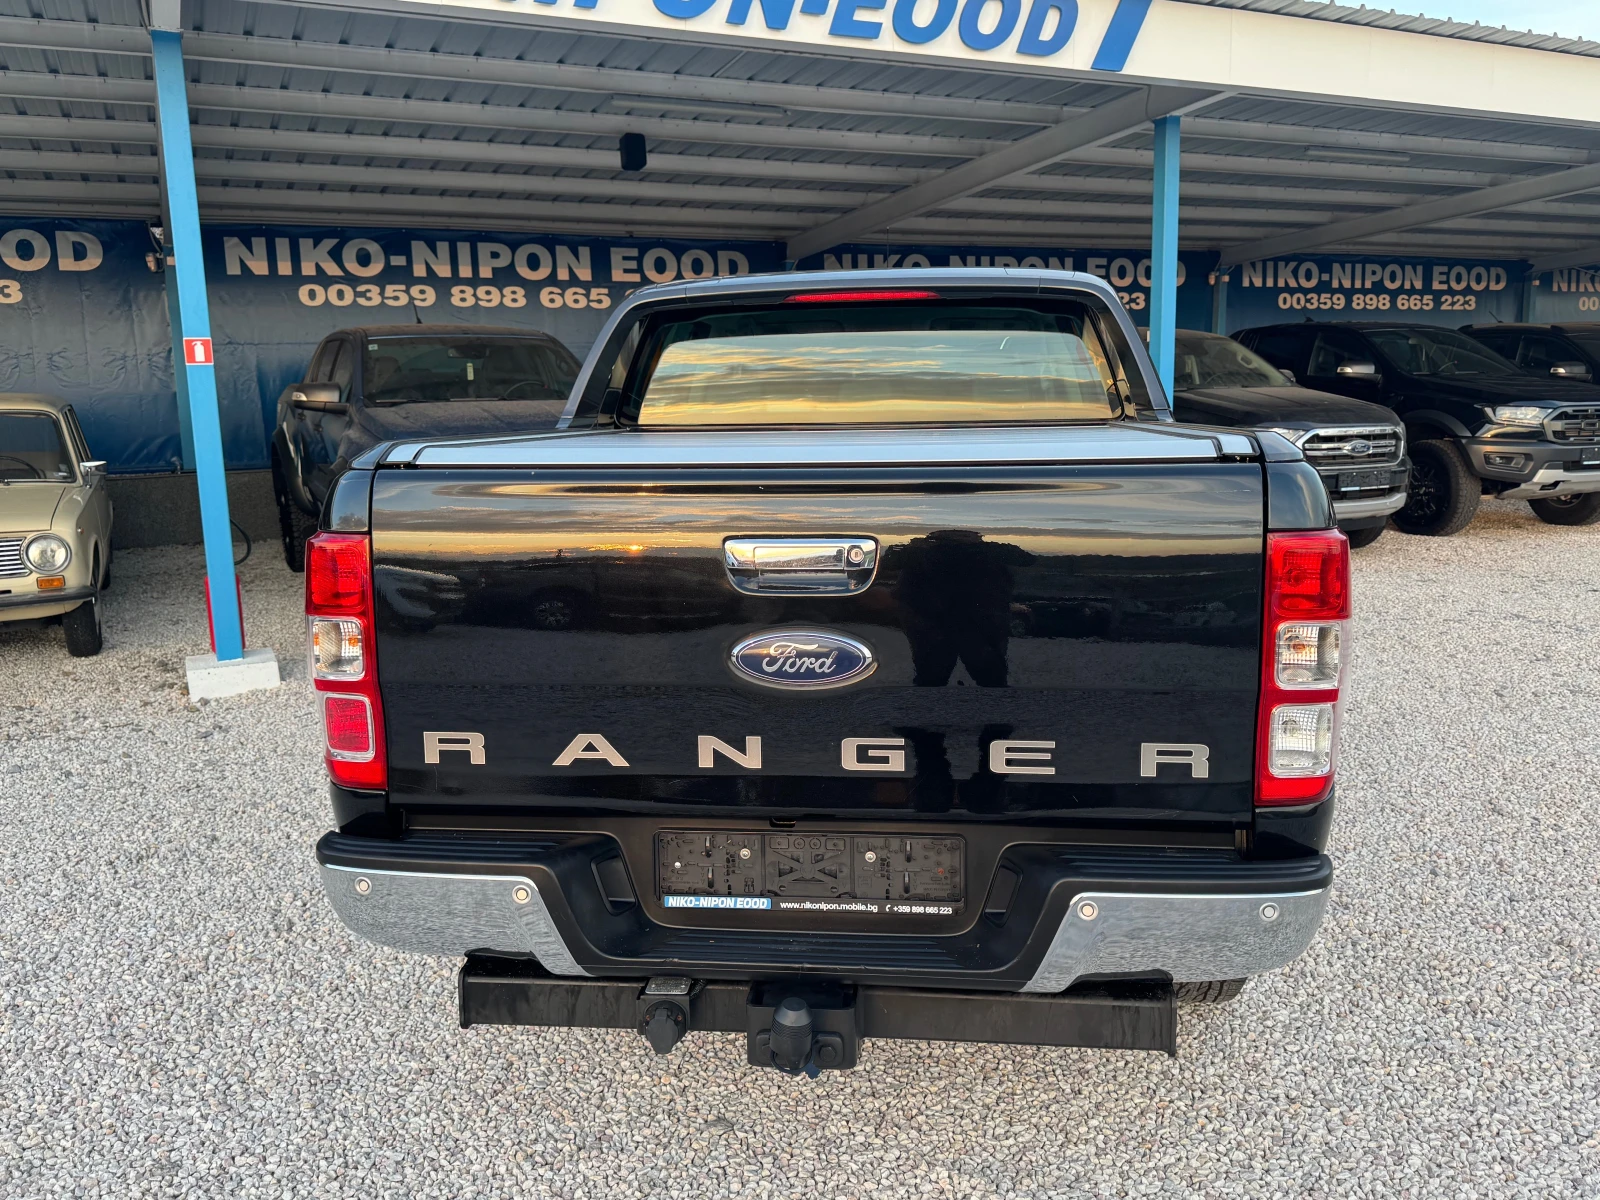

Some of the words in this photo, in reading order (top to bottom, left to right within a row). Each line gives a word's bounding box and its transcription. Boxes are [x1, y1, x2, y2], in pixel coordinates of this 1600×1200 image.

[223, 236, 592, 281] NIKO-NIPON
[610, 246, 749, 283] EOOD
[1242, 261, 1423, 291] NIKO-NIPON
[1432, 265, 1507, 291] EOOD
[1552, 269, 1600, 293] NIK
[298, 283, 437, 307] 00359
[450, 285, 527, 309] 898
[539, 286, 612, 309] 665
[1277, 292, 1346, 310] 00359
[1351, 293, 1391, 310] 898
[1396, 294, 1435, 311] 665
[1440, 295, 1476, 311] 223
[761, 641, 839, 673] Ford
[423, 731, 1209, 779] RANGER
[668, 896, 736, 908] NIKO-NIPON
[737, 897, 768, 909] EOOD
[779, 901, 879, 912] www.nikonipon.mobile.bg
[892, 904, 911, 913] +359
[911, 905, 925, 914] 898
[925, 905, 939, 914] 665
[939, 906, 953, 915] 223
